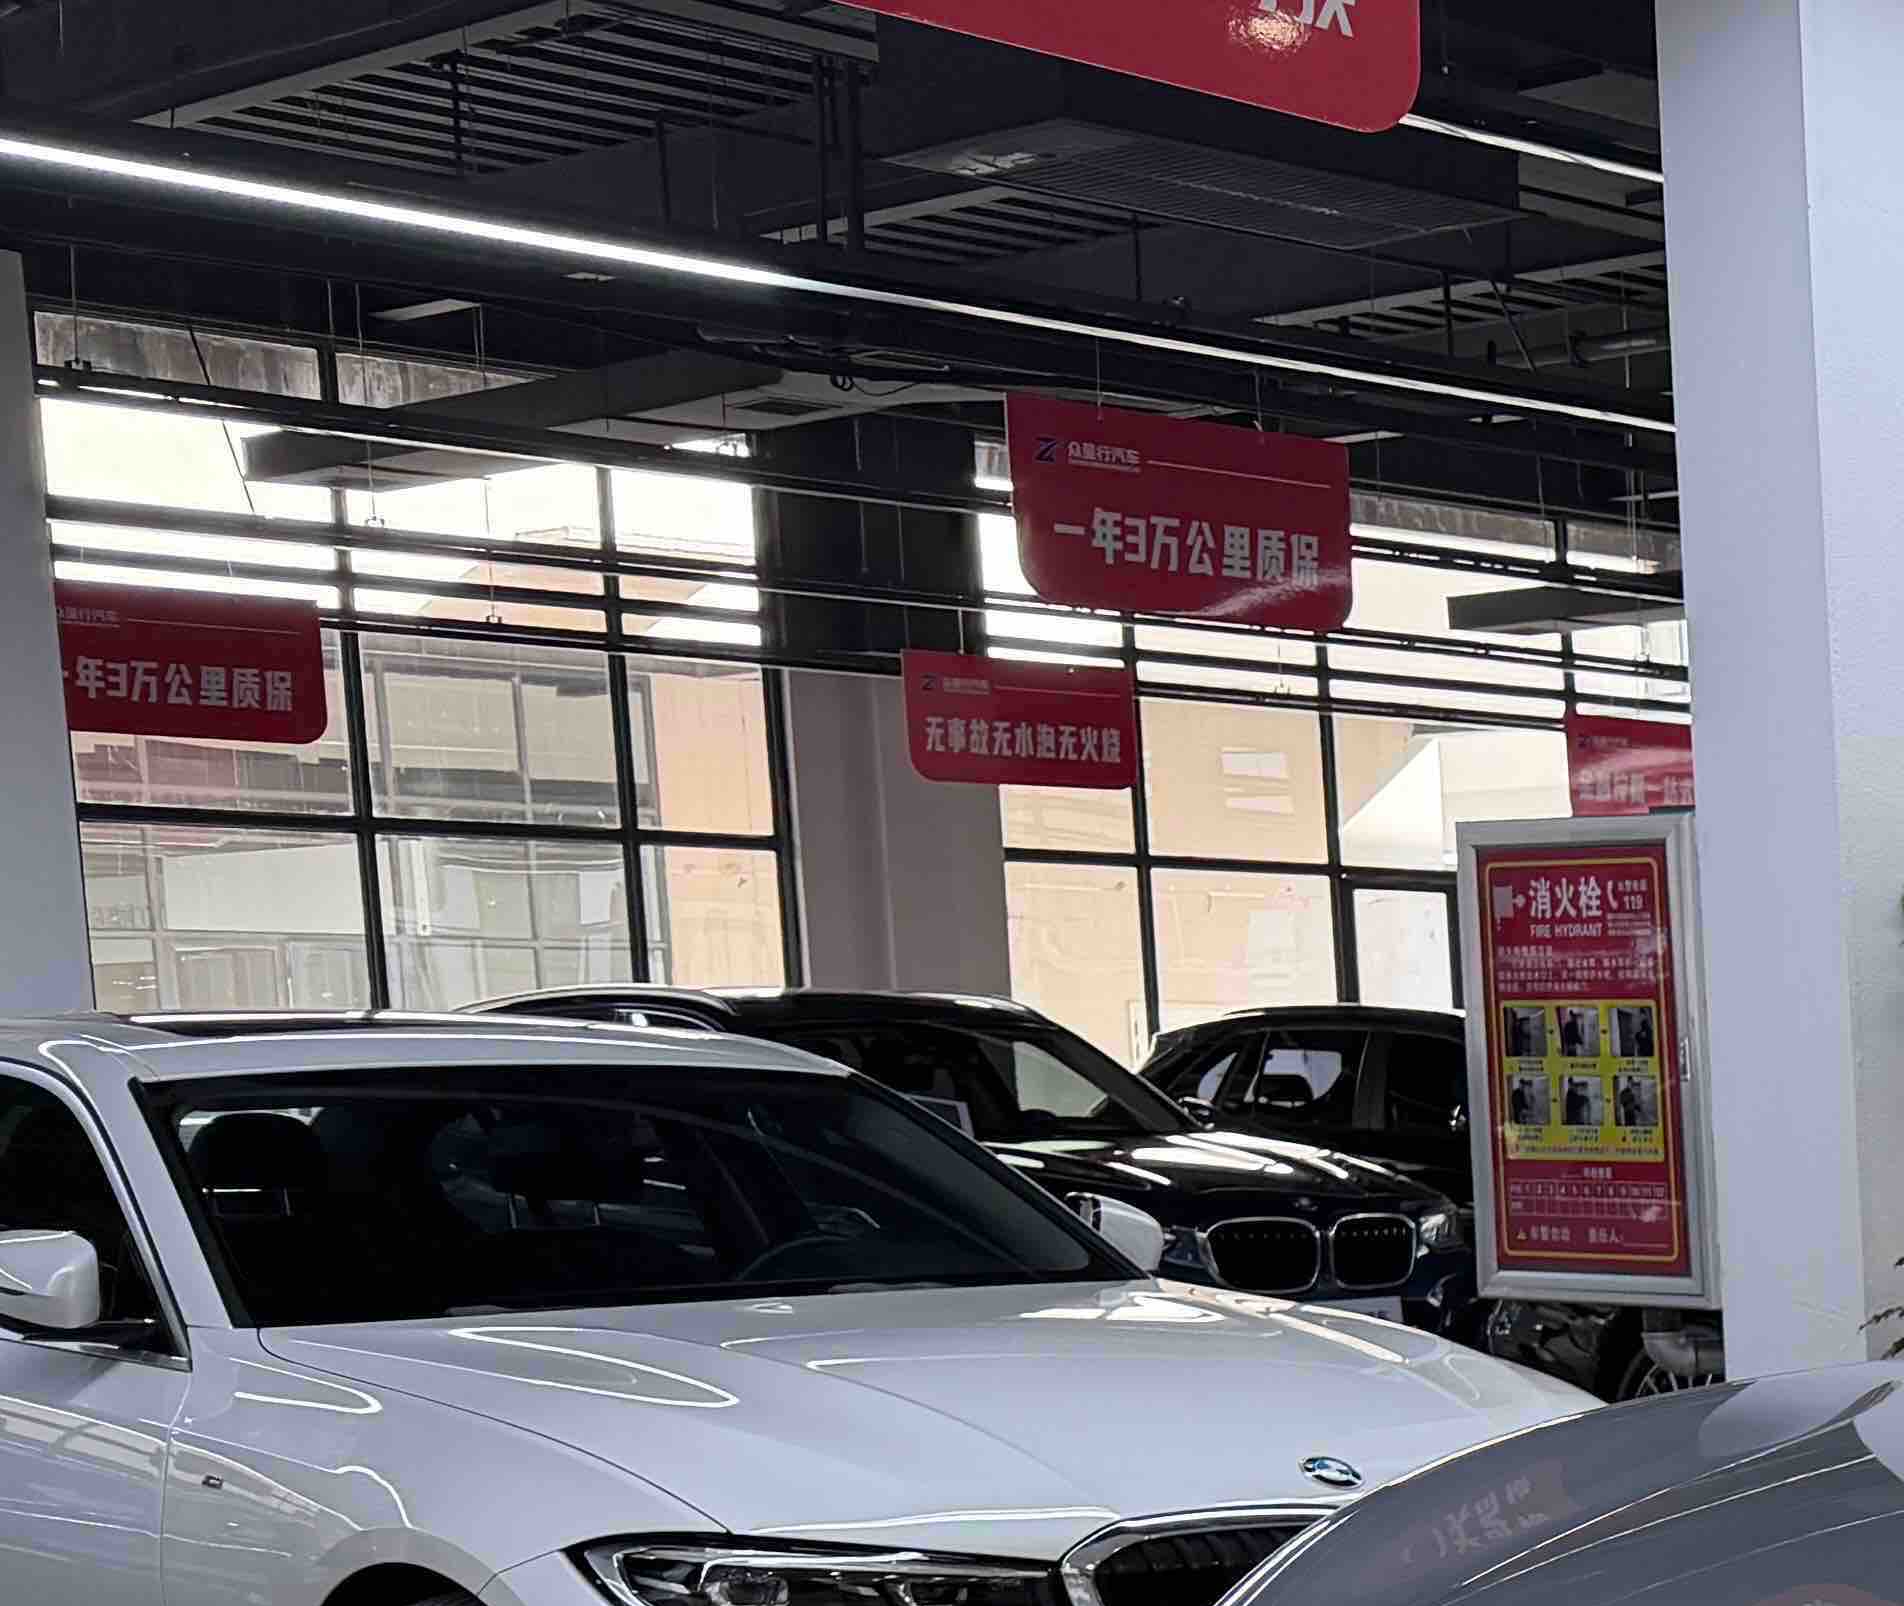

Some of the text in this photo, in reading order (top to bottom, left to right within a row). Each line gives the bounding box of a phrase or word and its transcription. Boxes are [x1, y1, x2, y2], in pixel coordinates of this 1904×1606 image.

[1053, 506, 1320, 589] 一年3万公里质保
[64, 655, 294, 713] 年3万公里质保
[925, 716, 1121, 763] 无事故无水泡无火烧
[1528, 876, 1603, 918] 消火栓
[1530, 924, 1551, 938] FIRE
[1554, 923, 1603, 937] HYDRANT
